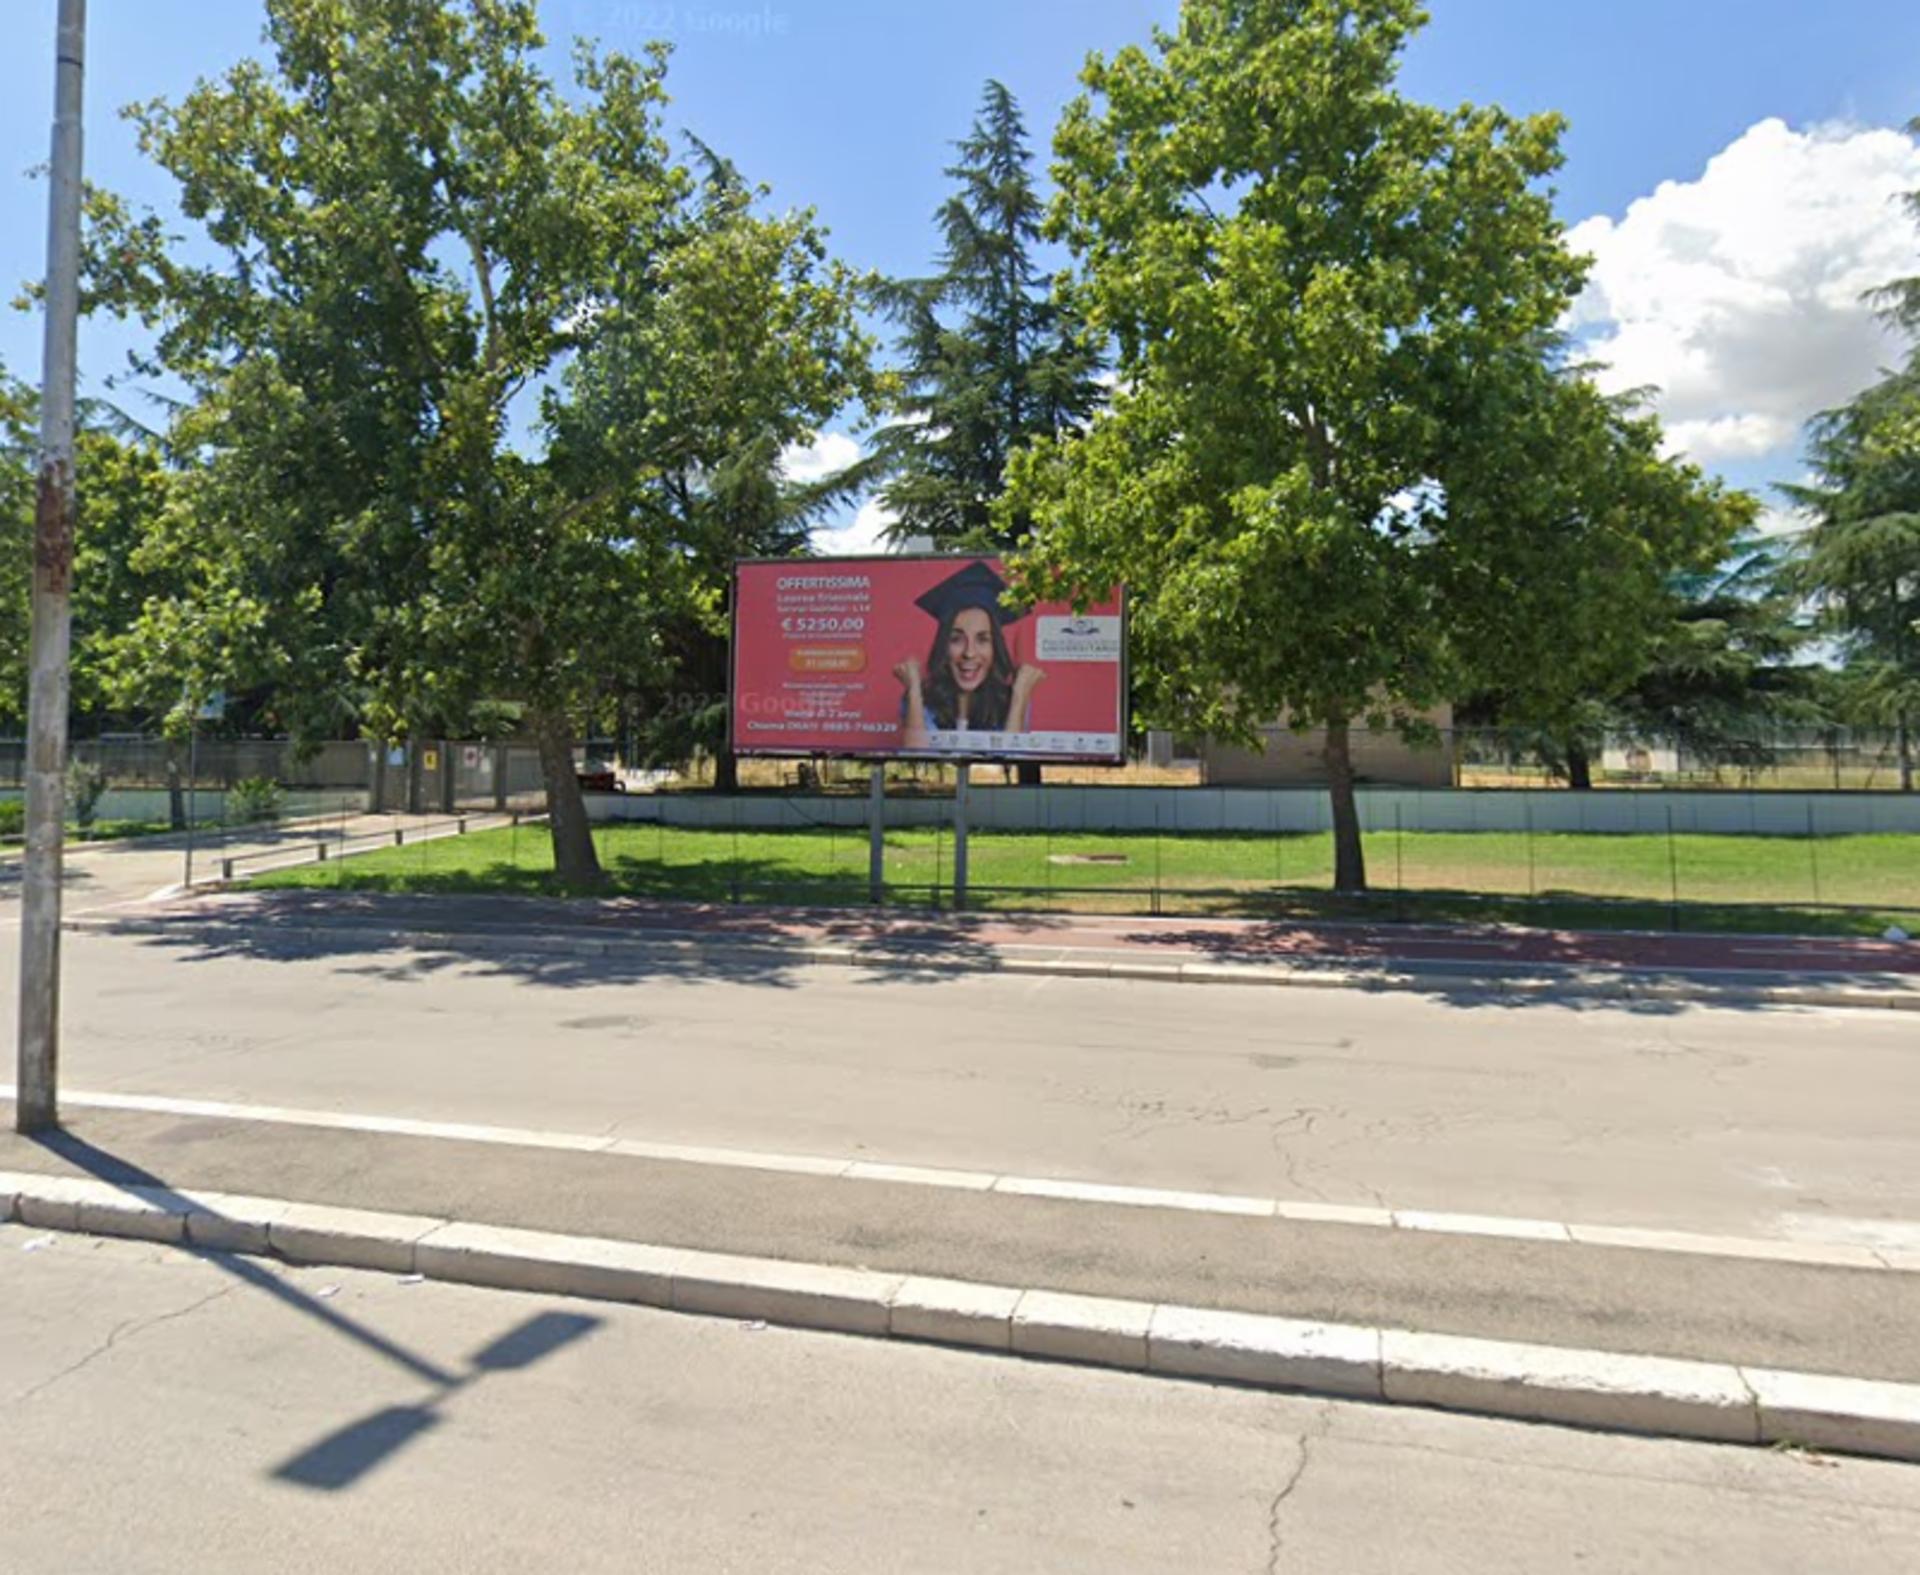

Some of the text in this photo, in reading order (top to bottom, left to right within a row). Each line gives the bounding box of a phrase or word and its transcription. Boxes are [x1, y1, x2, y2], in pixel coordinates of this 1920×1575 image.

[775, 575, 872, 590] OFFERTISSIMA
[780, 616, 865, 632] € 5250,00
